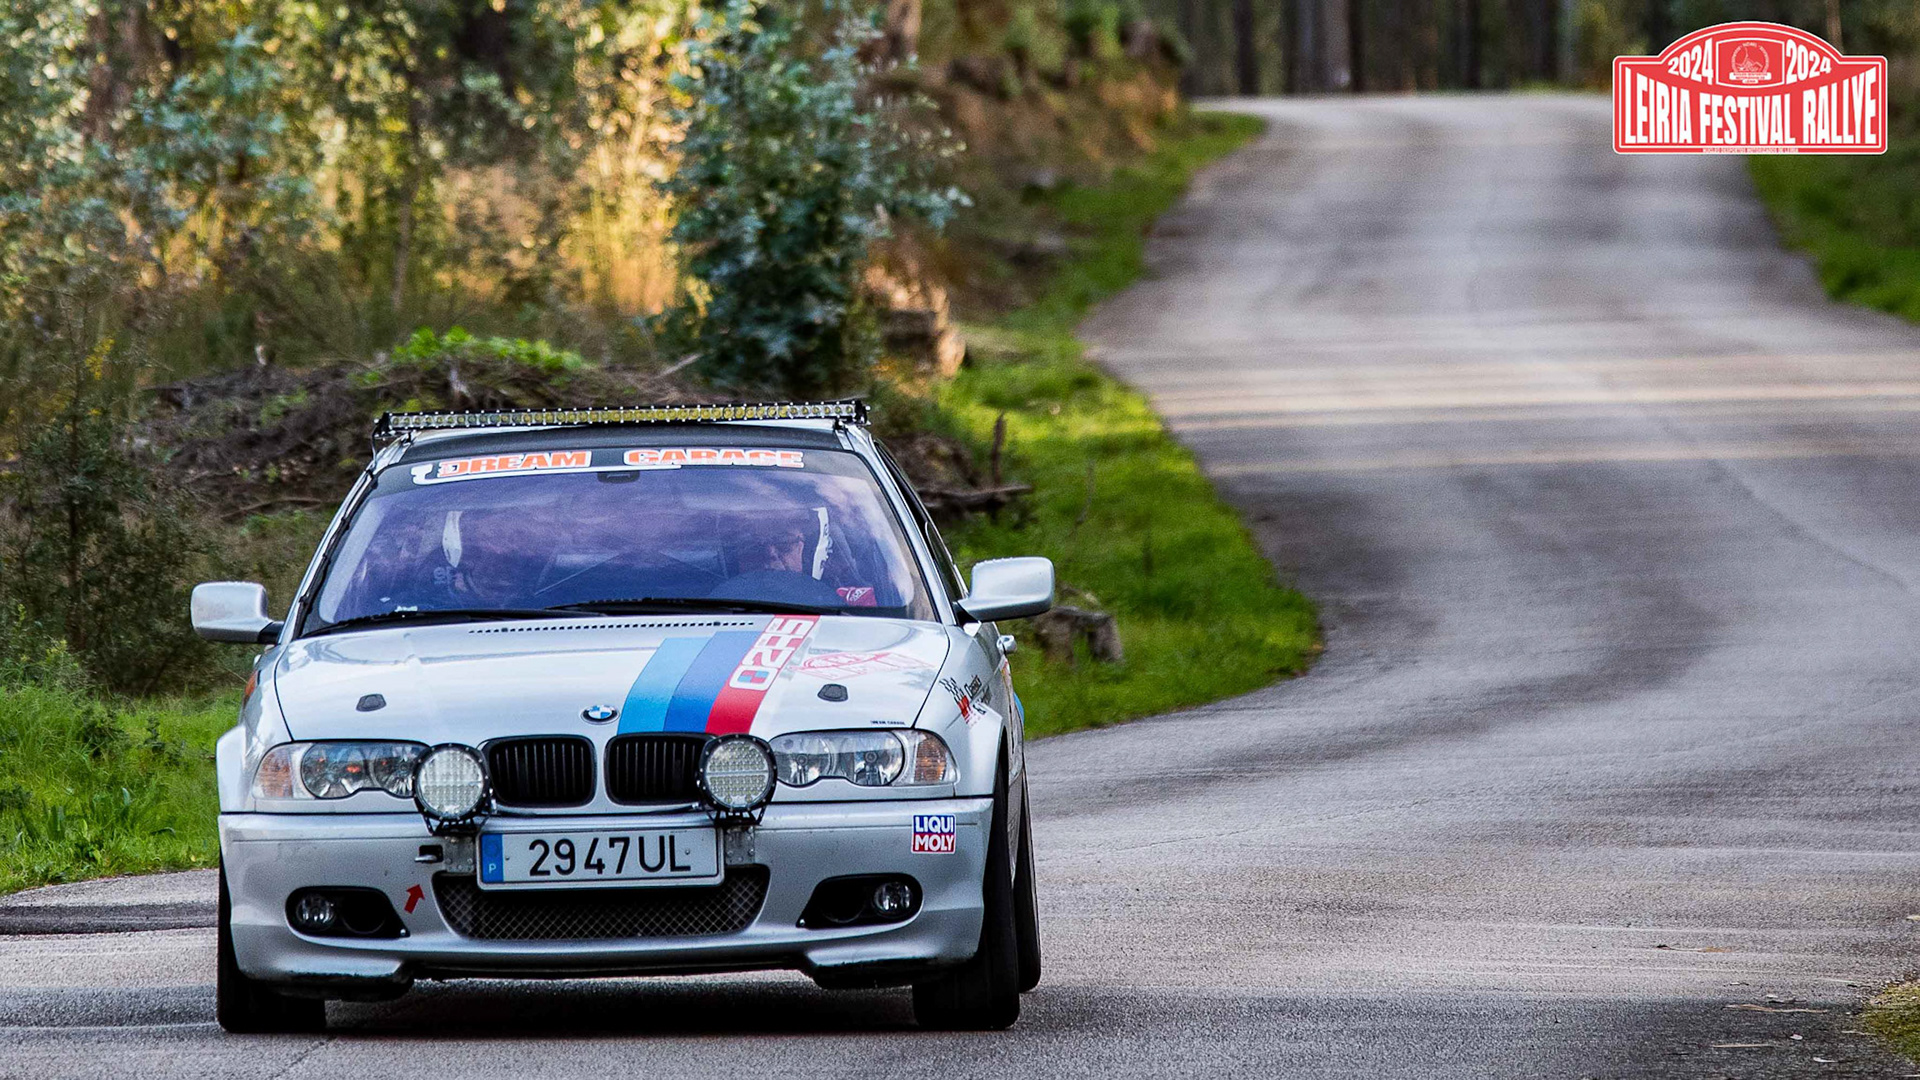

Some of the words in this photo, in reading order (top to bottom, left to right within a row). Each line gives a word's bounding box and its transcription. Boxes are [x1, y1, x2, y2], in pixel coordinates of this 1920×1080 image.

[438, 451, 591, 477] DREAM
[624, 449, 804, 468] GARAGE
[915, 816, 954, 833] LIQUI
[914, 834, 955, 852] MOLY
[488, 863, 496, 874] P
